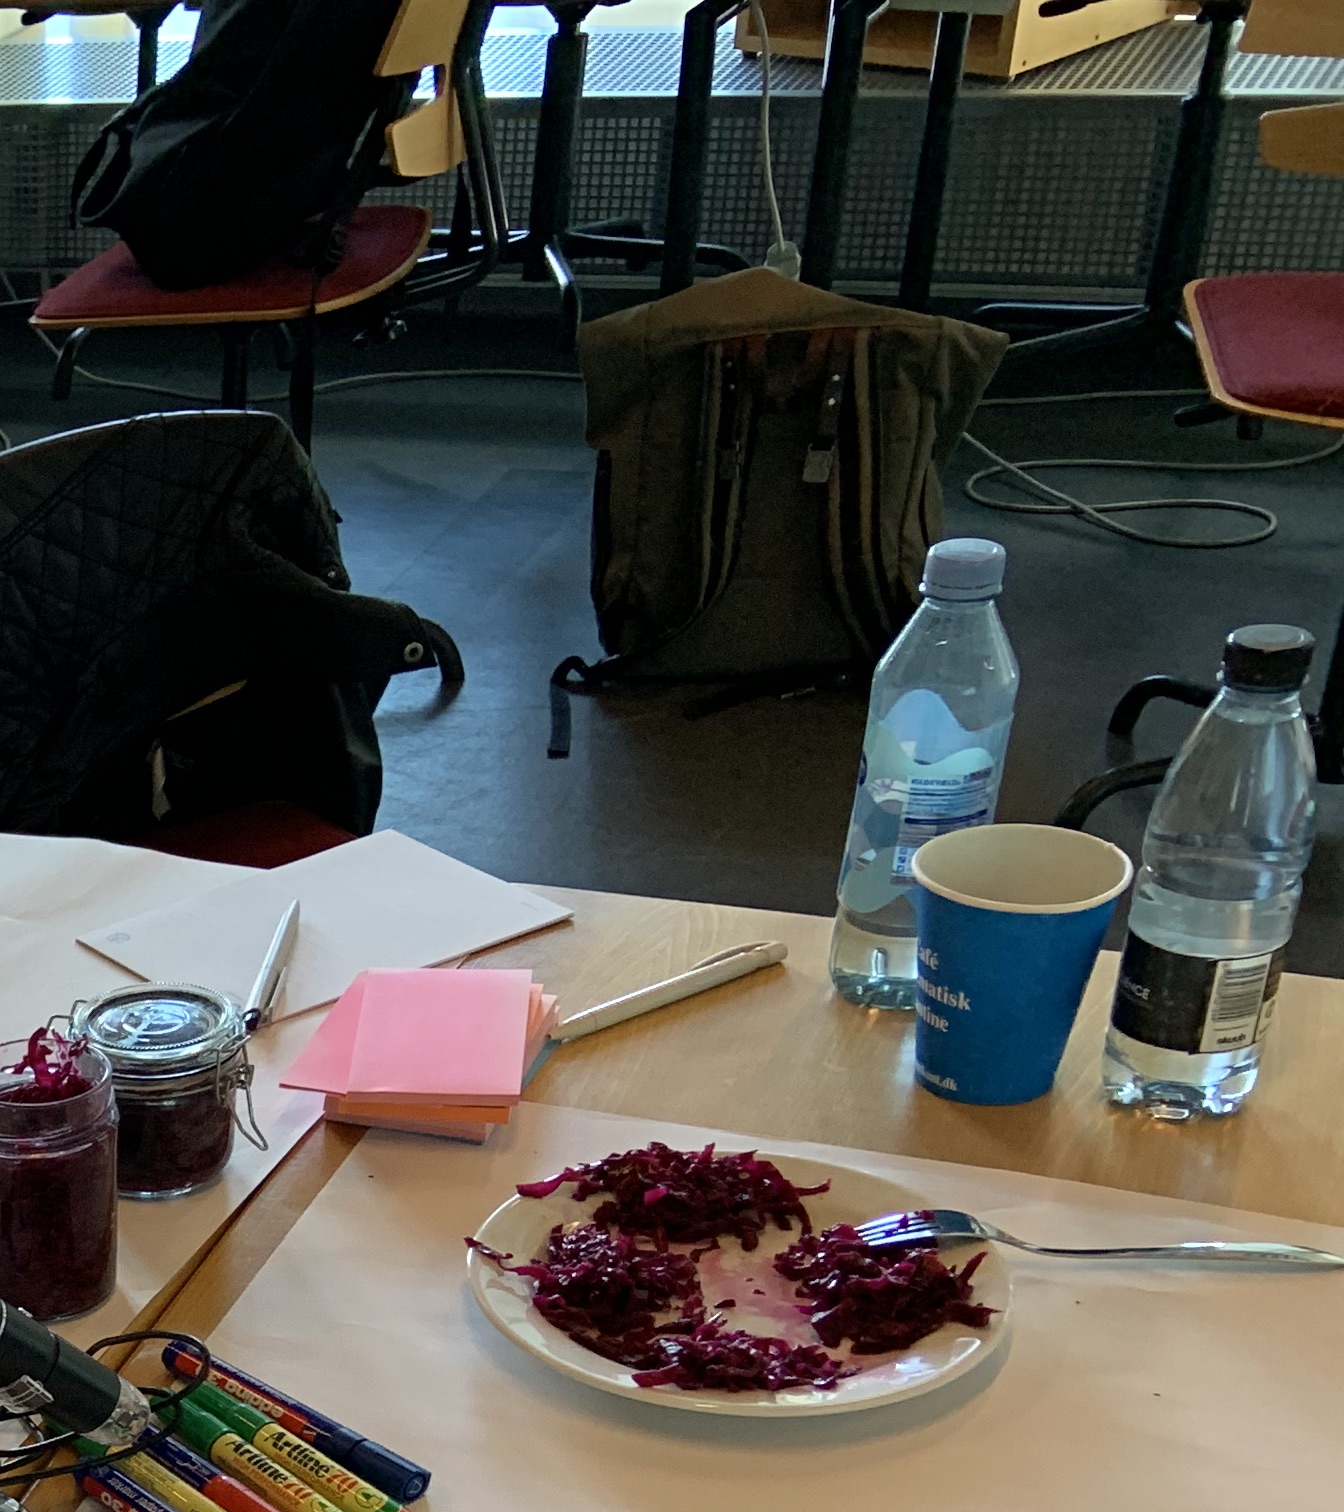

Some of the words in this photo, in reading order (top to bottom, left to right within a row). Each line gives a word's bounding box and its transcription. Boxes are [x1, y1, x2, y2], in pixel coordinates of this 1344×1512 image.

[918, 947, 940, 971] afé
[224, 1379, 285, 1418] edding
[224, 1440, 289, 1484] Artline
[263, 1431, 330, 1478] Artline
[325, 1469, 359, 1494] 70
